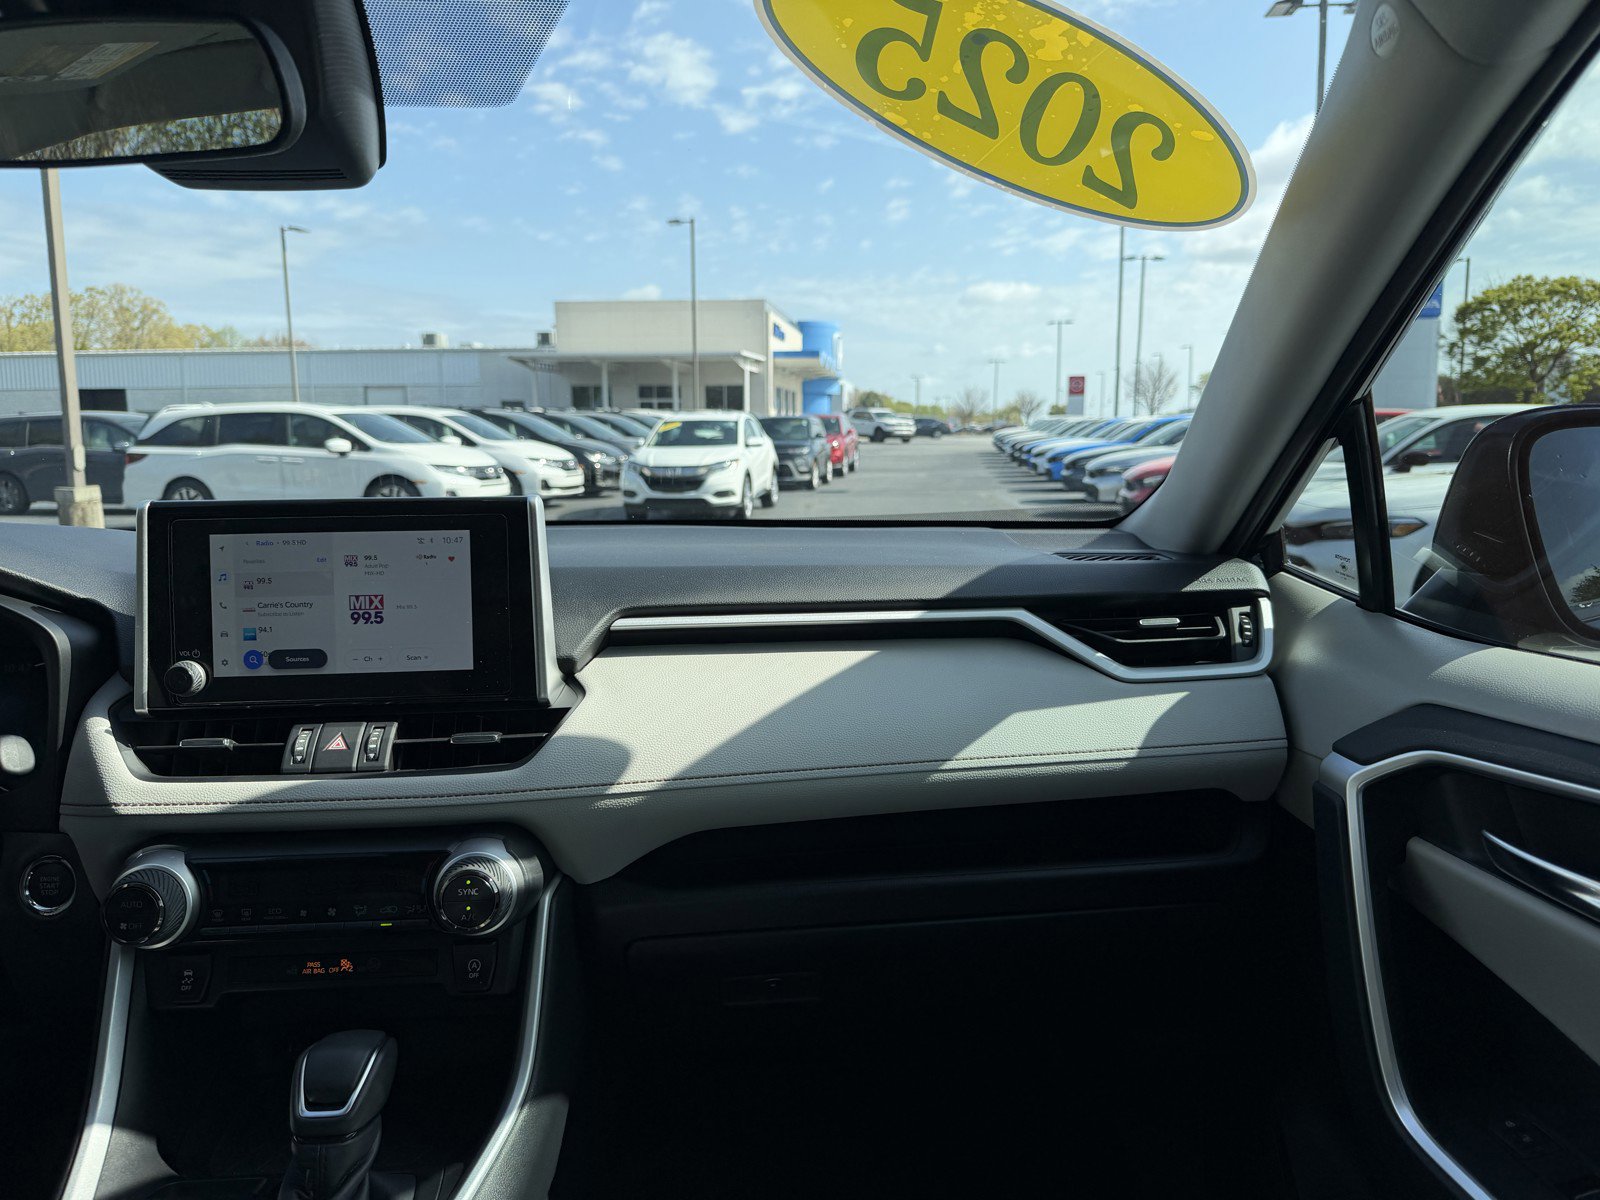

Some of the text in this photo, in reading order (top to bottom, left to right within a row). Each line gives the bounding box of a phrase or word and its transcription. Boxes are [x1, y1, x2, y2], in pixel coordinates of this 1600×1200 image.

[442, 536, 464, 544] 10:47
[257, 577, 273, 585] 99.5
[257, 601, 314, 609] Carrie's Country
[350, 595, 384, 610] MIX
[350, 611, 384, 624] 99.5
[258, 626, 273, 634] 94.1
[458, 888, 480, 896] SYNC
[120, 900, 143, 909] AUTO
[128, 922, 145, 930] OFF
